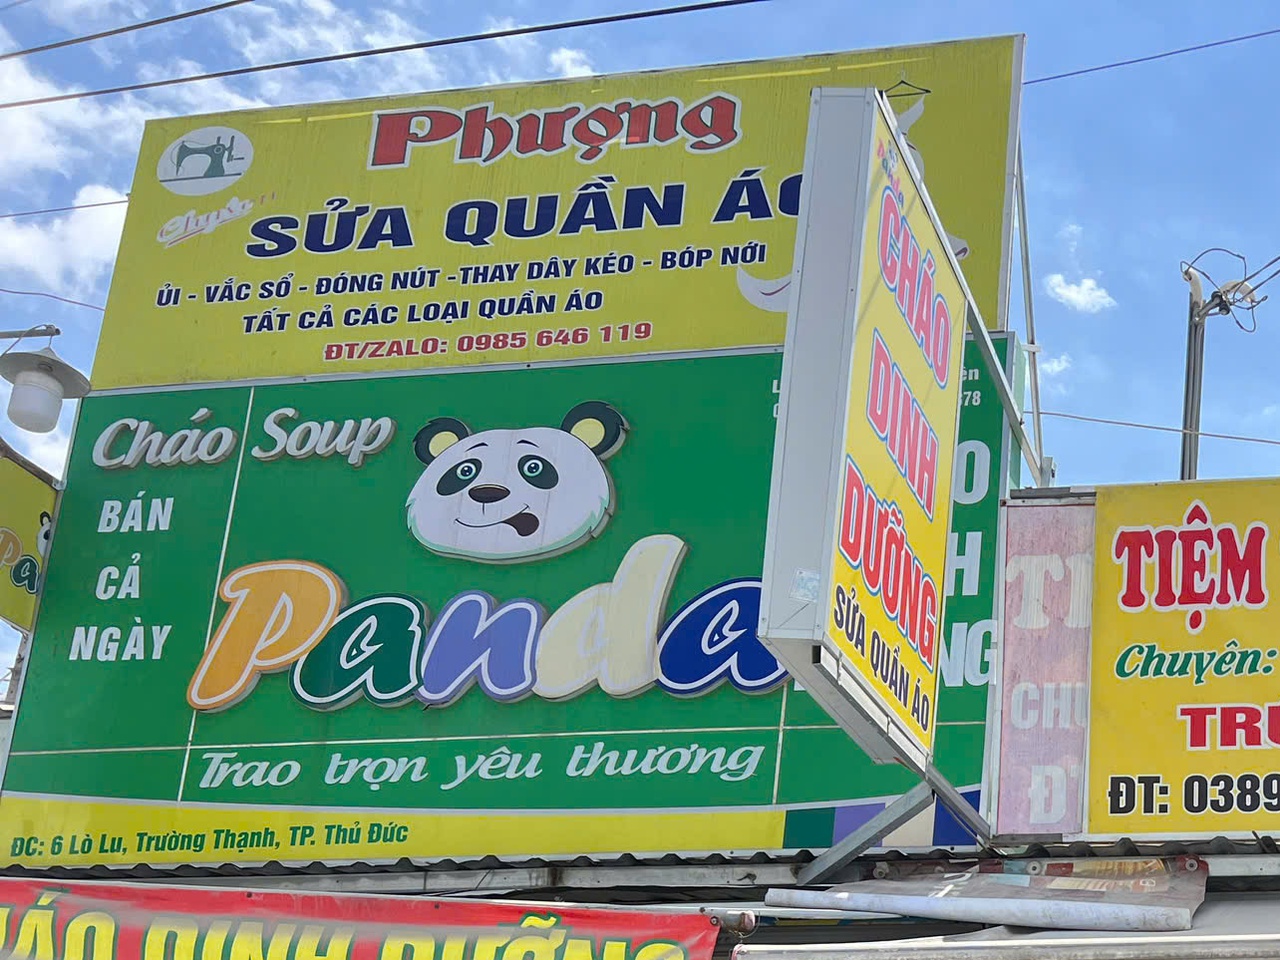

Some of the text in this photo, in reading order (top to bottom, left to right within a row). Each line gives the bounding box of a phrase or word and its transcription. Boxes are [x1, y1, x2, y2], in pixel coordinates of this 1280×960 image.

[368, 91, 742, 171] Phượng
[246, 196, 432, 259] SỬA
[443, 175, 689, 247] QUẦN
[156, 282, 181, 307] ỦI
[205, 277, 250, 303] VẮC
[315, 273, 383, 296] ĐÓNG
[391, 266, 441, 290] NÚT
[526, 255, 578, 281] DÂY
[584, 253, 635, 276] KÉO
[660, 245, 713, 270] BÓP
[720, 241, 767, 266] NỚI
[878, 185, 952, 390] CHÁO
[242, 288, 604, 334] TẤT CẢ CÁC LOẠI QUẦN ÁO
[324, 322, 652, 361] ĐT/ZALO: 0985 646 119
[92, 407, 397, 469] Cháo Soup
[866, 326, 939, 522] DINH
[98, 485, 174, 534] BÁN
[95, 551, 141, 600] CẢ
[837, 453, 938, 673] DƯỠNG
[1113, 499, 1268, 634] TIỆM
[69, 612, 171, 663] NGÀY
[187, 534, 790, 713] Panda
[833, 583, 930, 733] SỬA QUẦN ÁO
[1115, 638, 1279, 686] Chuyên:
[199, 741, 766, 793] Trao trọn yêu thương
[1108, 775, 1170, 814] ĐT:
[10, 821, 409, 857] ĐC: 6 Lò Lu, Trường Thạnh, TP. Thủ Đức
